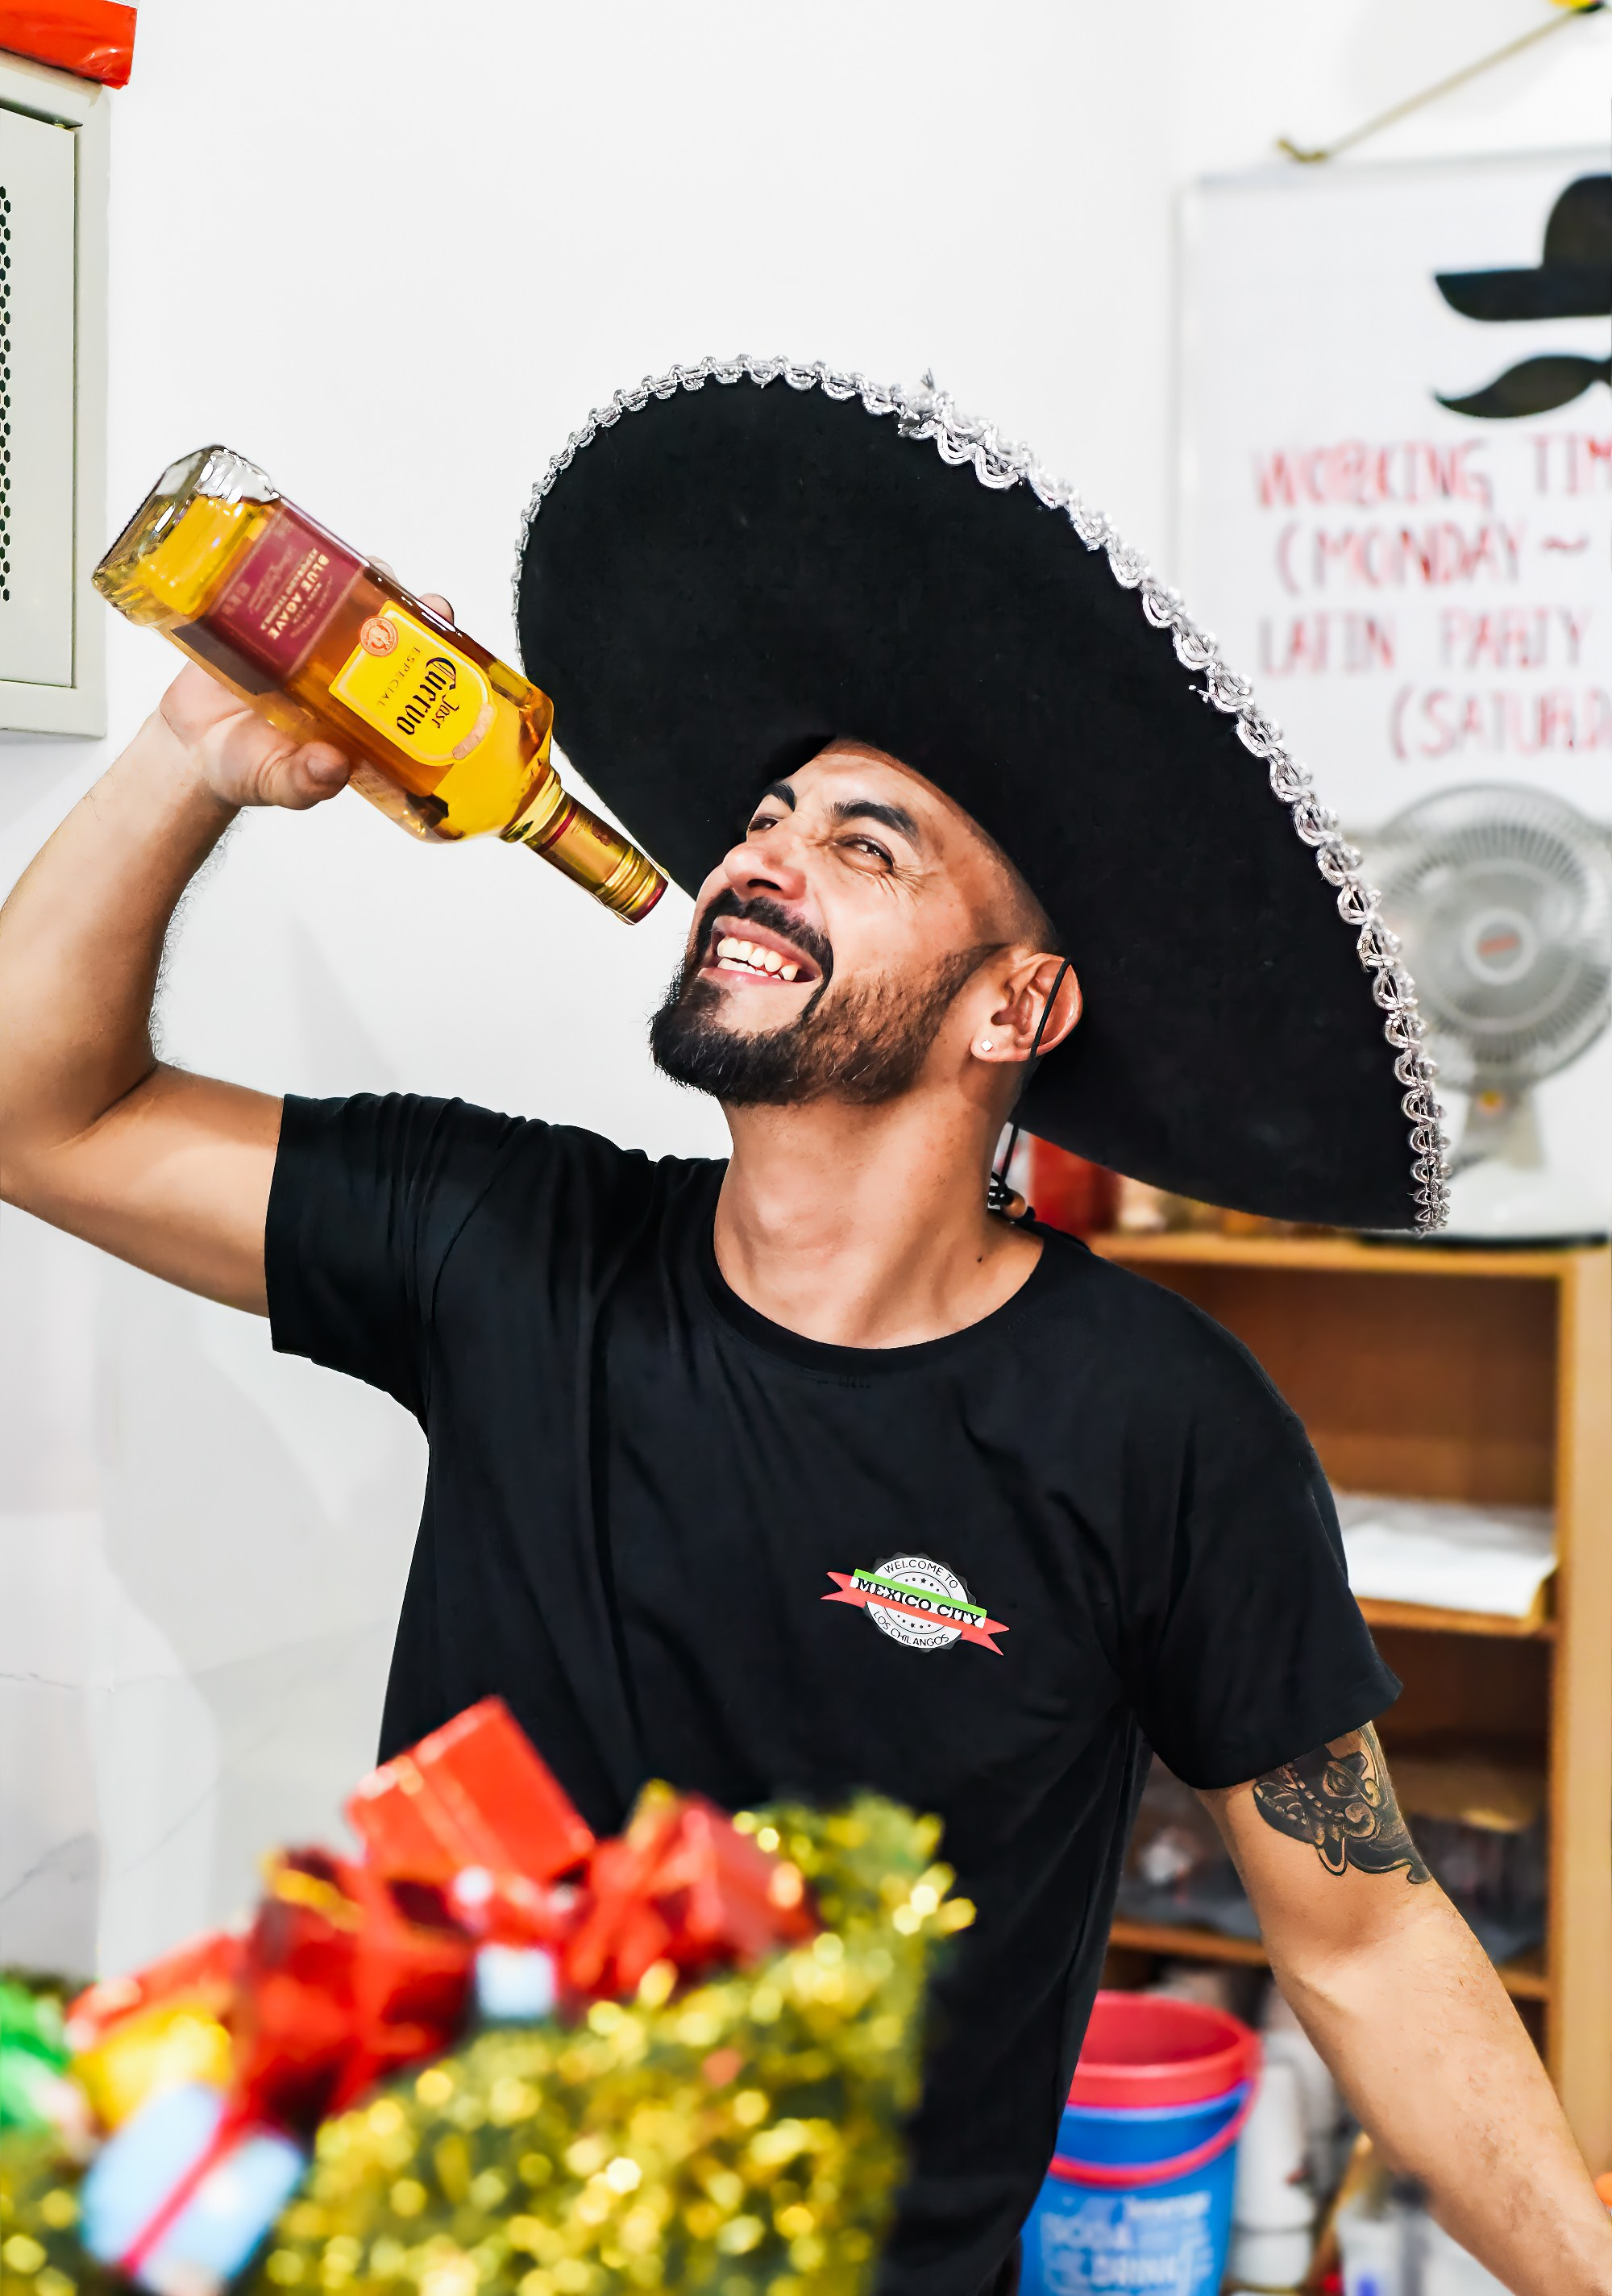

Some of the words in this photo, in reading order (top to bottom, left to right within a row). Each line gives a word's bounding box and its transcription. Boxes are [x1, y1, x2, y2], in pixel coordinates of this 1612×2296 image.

[1256, 439, 1493, 510] WORKING
[298, 553, 330, 593] BLUE
[266, 591, 305, 640] AGAVE
[1258, 608, 1396, 679] LATIN
[1440, 605, 1590, 672] PARTY
[376, 646, 421, 708] ESPECIAL
[397, 657, 456, 736] Cuervo
[883, 1559, 944, 1576] WELCOME
[946, 1574, 958, 1589] TO
[857, 1578, 932, 1612] MEXICO
[937, 1603, 982, 1627] CITY
[873, 1611, 891, 1630] LOS
[890, 1628, 949, 1648] CHILANGOS
